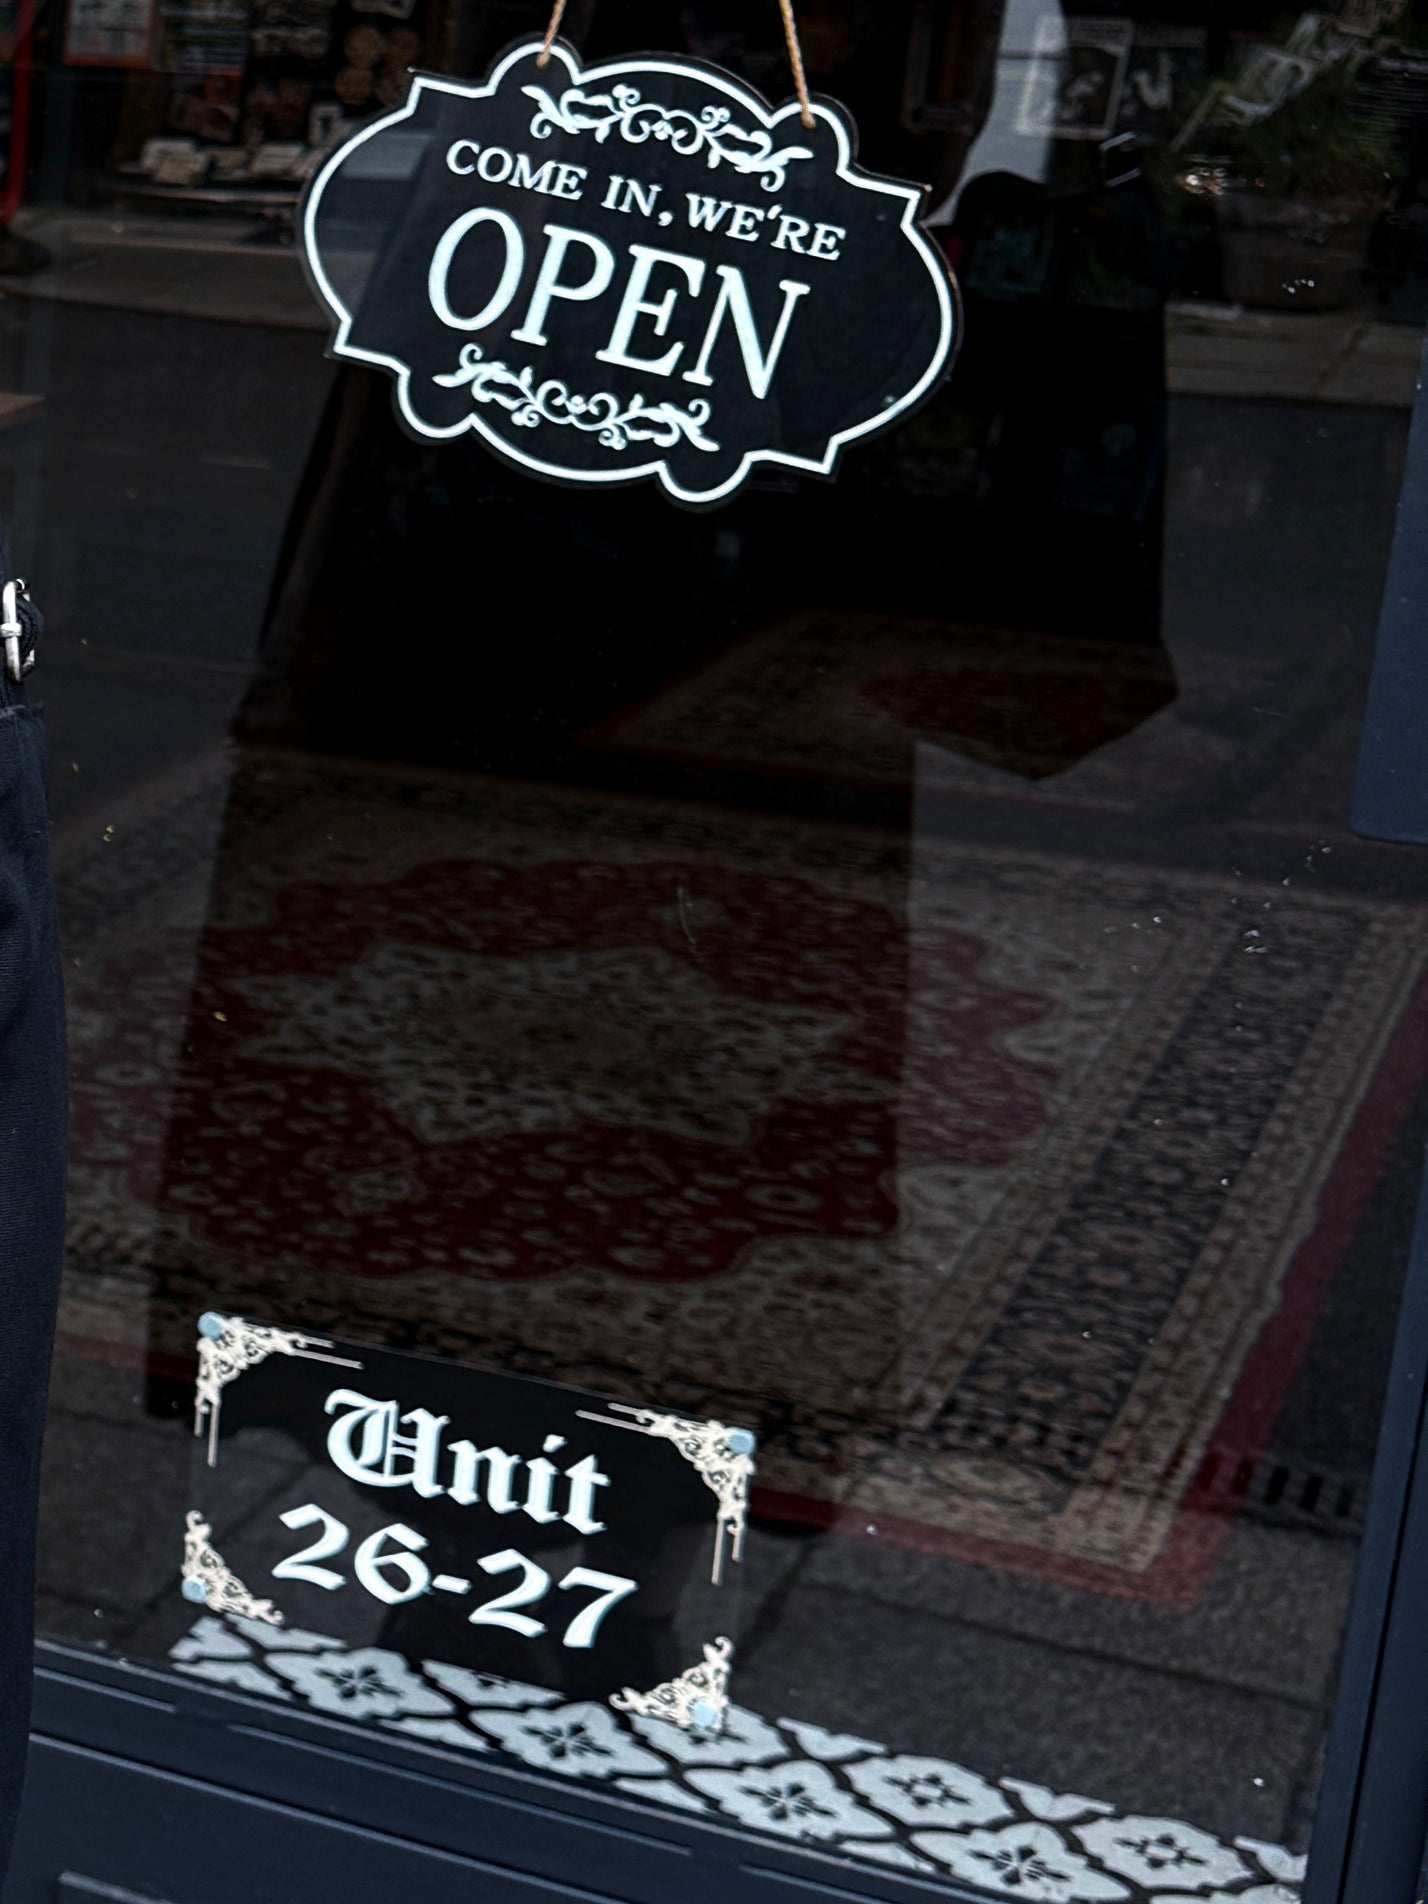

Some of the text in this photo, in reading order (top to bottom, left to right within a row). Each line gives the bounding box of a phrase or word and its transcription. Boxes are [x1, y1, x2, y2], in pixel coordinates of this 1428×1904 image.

[447, 140, 847, 261] COME IN, WE'RE
[427, 205, 810, 400] OPEN
[324, 1388, 610, 1536] Unit
[271, 1503, 638, 1649] 26-27
